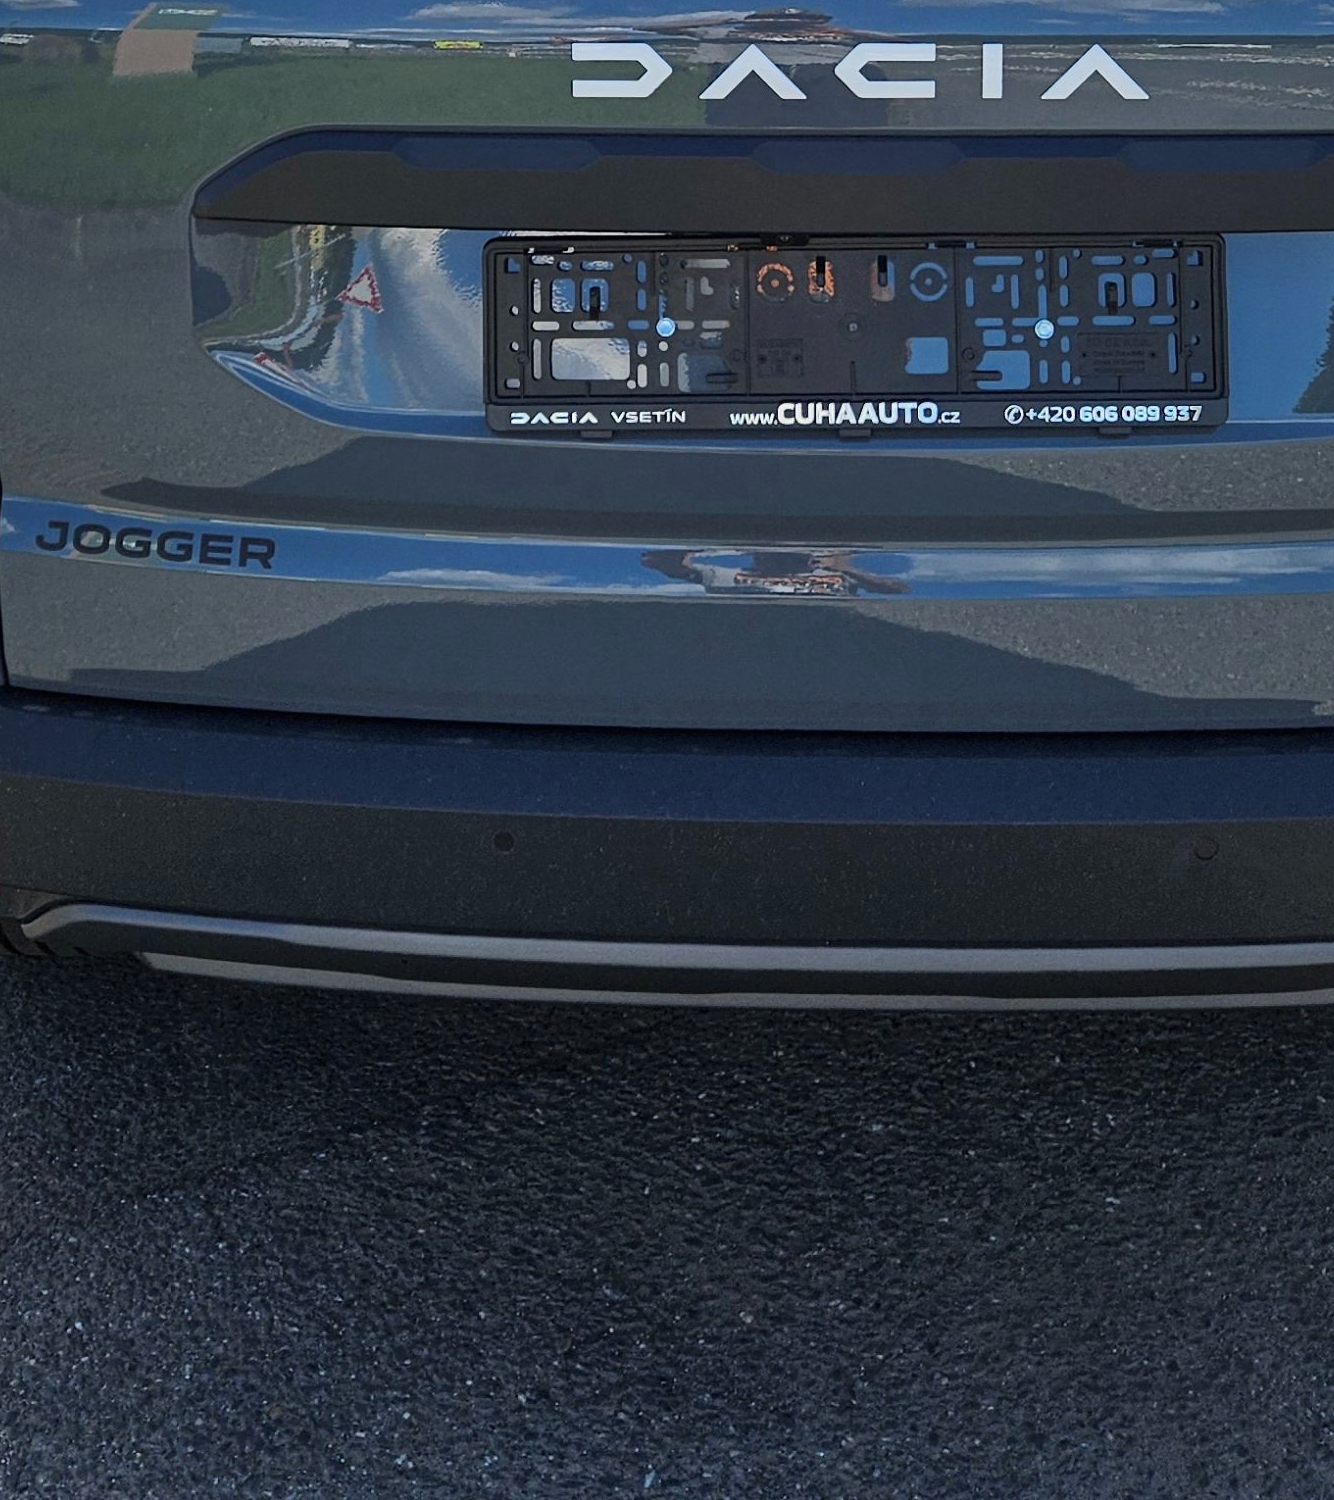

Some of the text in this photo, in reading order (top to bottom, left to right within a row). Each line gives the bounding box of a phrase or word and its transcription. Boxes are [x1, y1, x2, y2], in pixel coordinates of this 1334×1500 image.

[571, 42, 1151, 101] DACIA
[510, 408, 686, 425] DACIA VSETÍN
[729, 401, 961, 426] www.CUHAAUTO.cz
[1025, 405, 1203, 423] +420 606 089 937
[34, 519, 277, 570] JOGGER
